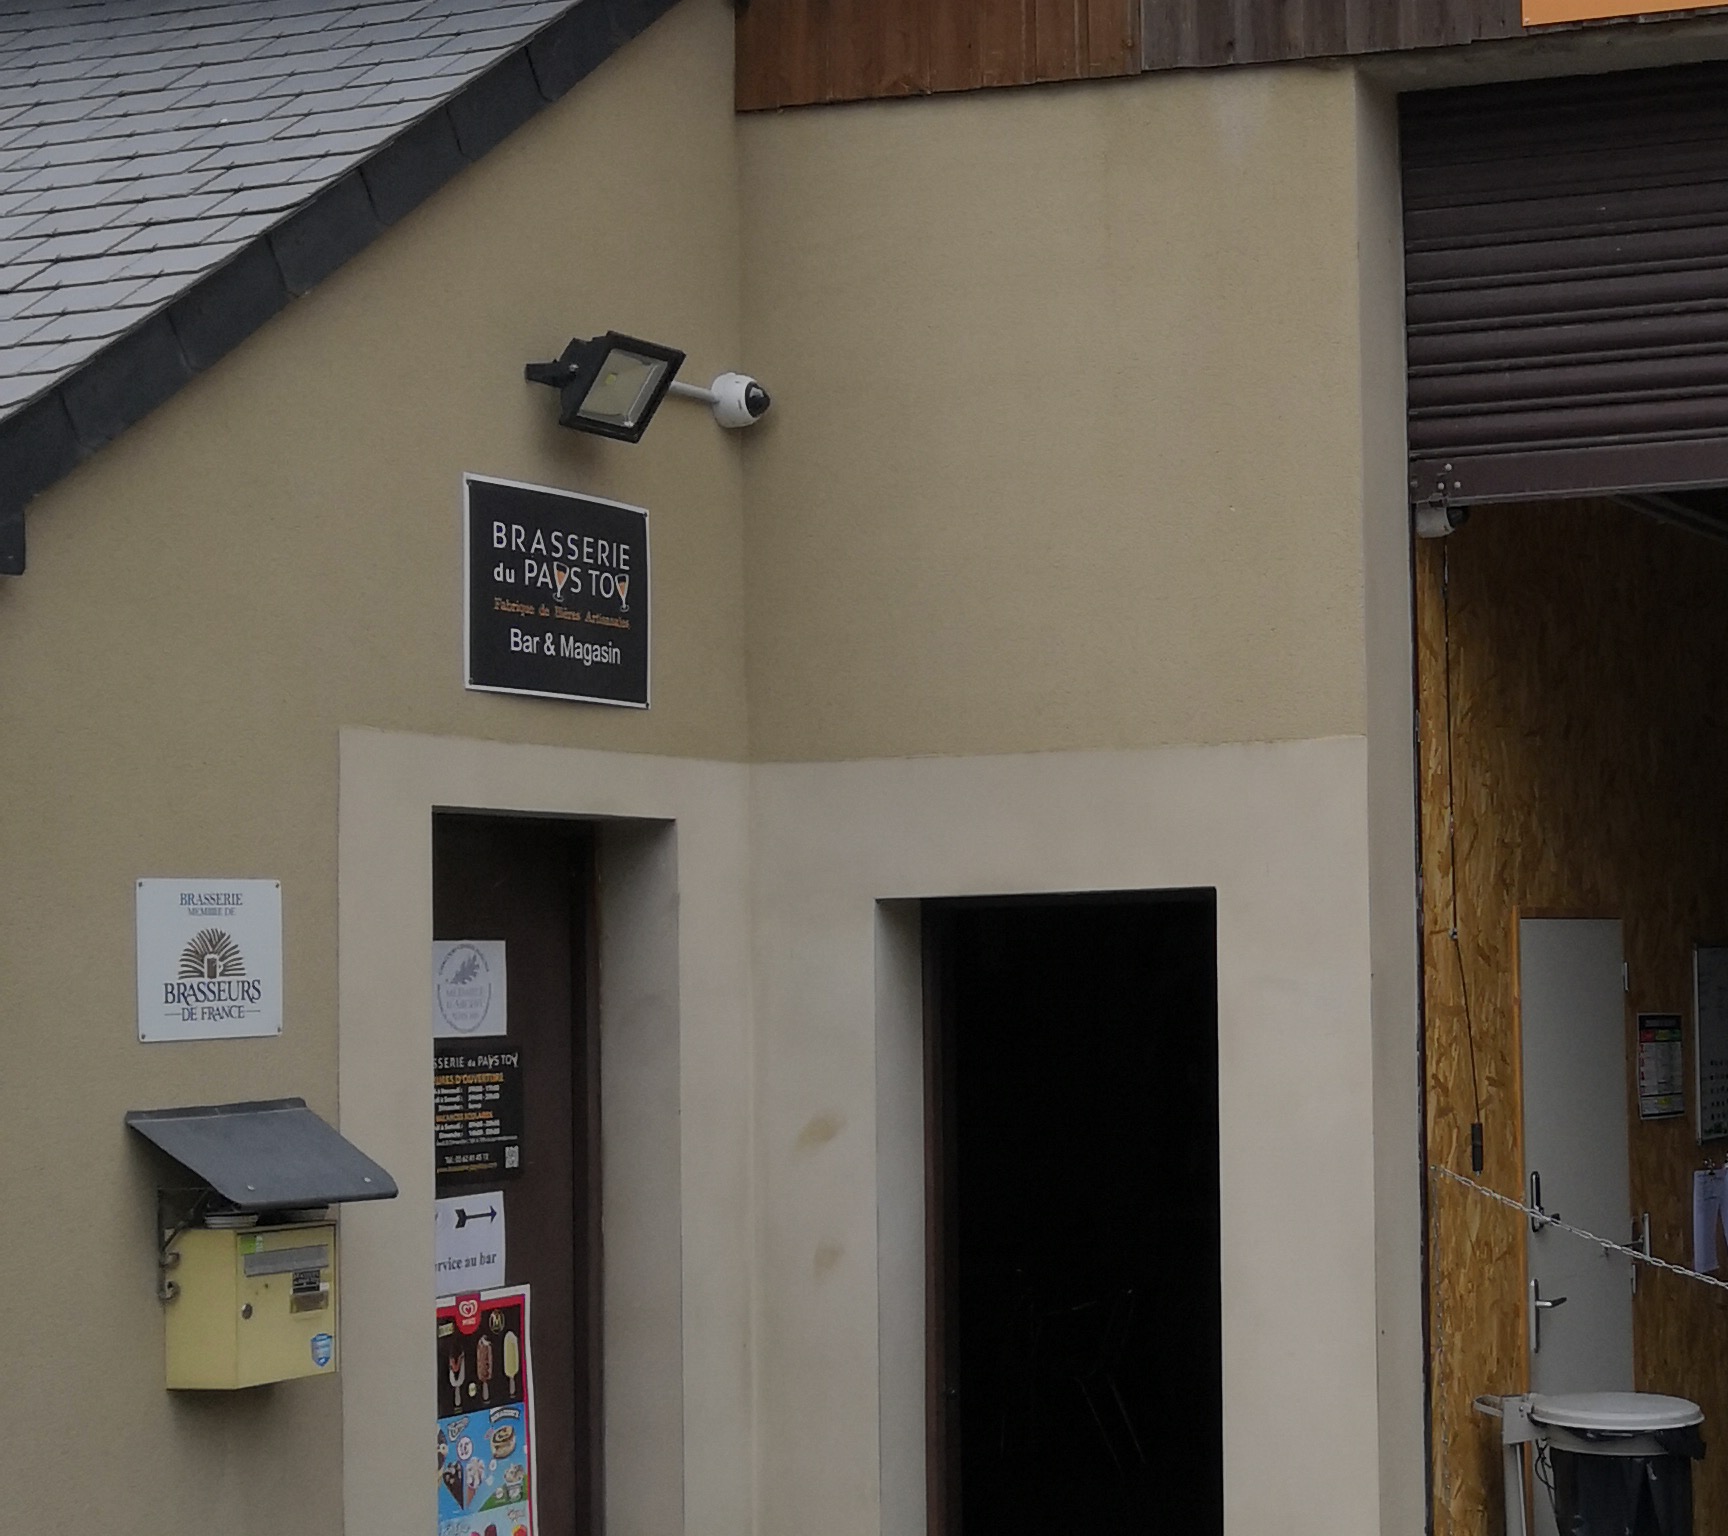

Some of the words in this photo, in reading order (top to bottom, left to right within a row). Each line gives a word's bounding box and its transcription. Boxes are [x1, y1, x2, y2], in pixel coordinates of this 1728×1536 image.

[493, 520, 631, 571] BRASSERIE
[493, 562, 515, 583] du
[525, 559, 582, 602] PAYS
[588, 569, 630, 612] TOY
[510, 628, 540, 654] Bar
[543, 632, 556, 657] &
[560, 634, 621, 666] Magasin
[180, 892, 243, 906] BRASSERIE
[164, 979, 262, 1006] BRASSEURS
[181, 1007, 198, 1022] DE
[200, 1005, 245, 1022] FRANCE
[464, 1257, 477, 1268] au
[479, 1252, 497, 1266] bar
